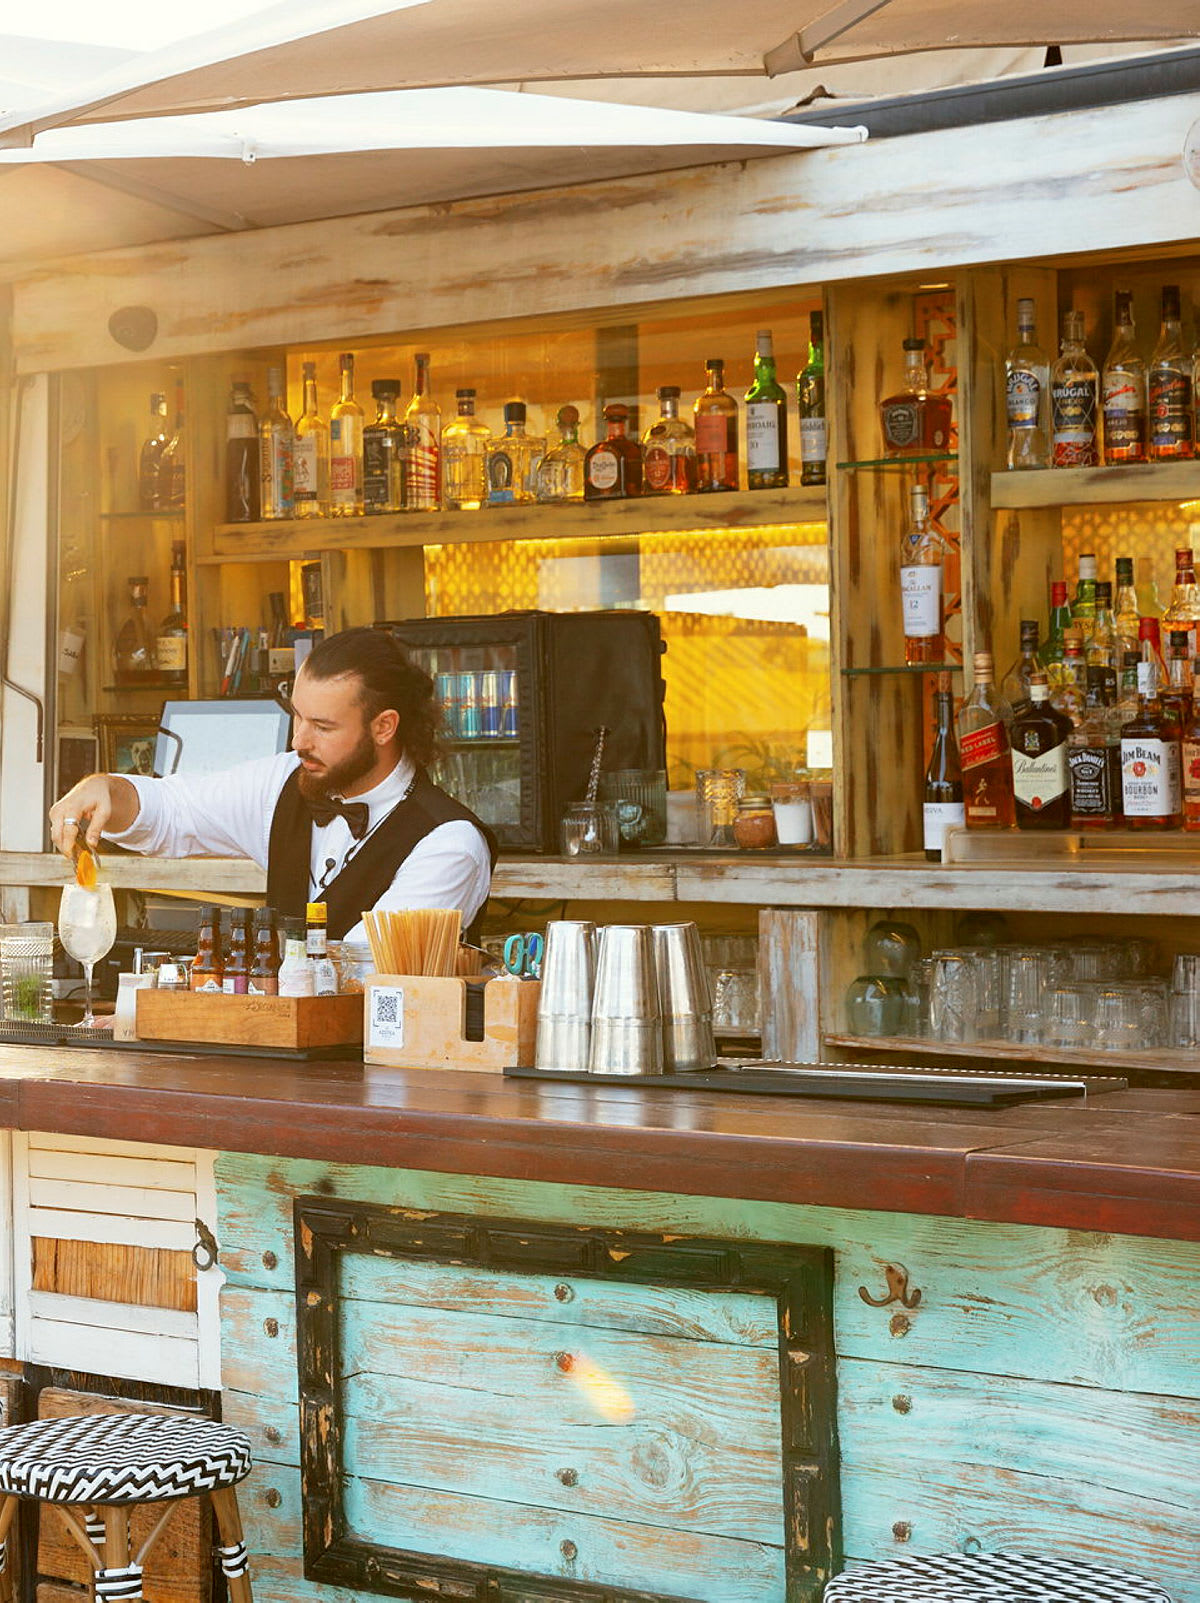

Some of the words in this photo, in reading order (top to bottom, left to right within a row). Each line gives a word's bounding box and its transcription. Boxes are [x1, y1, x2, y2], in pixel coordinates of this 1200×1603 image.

[1122, 750, 1135, 765] JIM
[1136, 746, 1161, 765] BEAM
[1125, 785, 1158, 794] BOURBON
